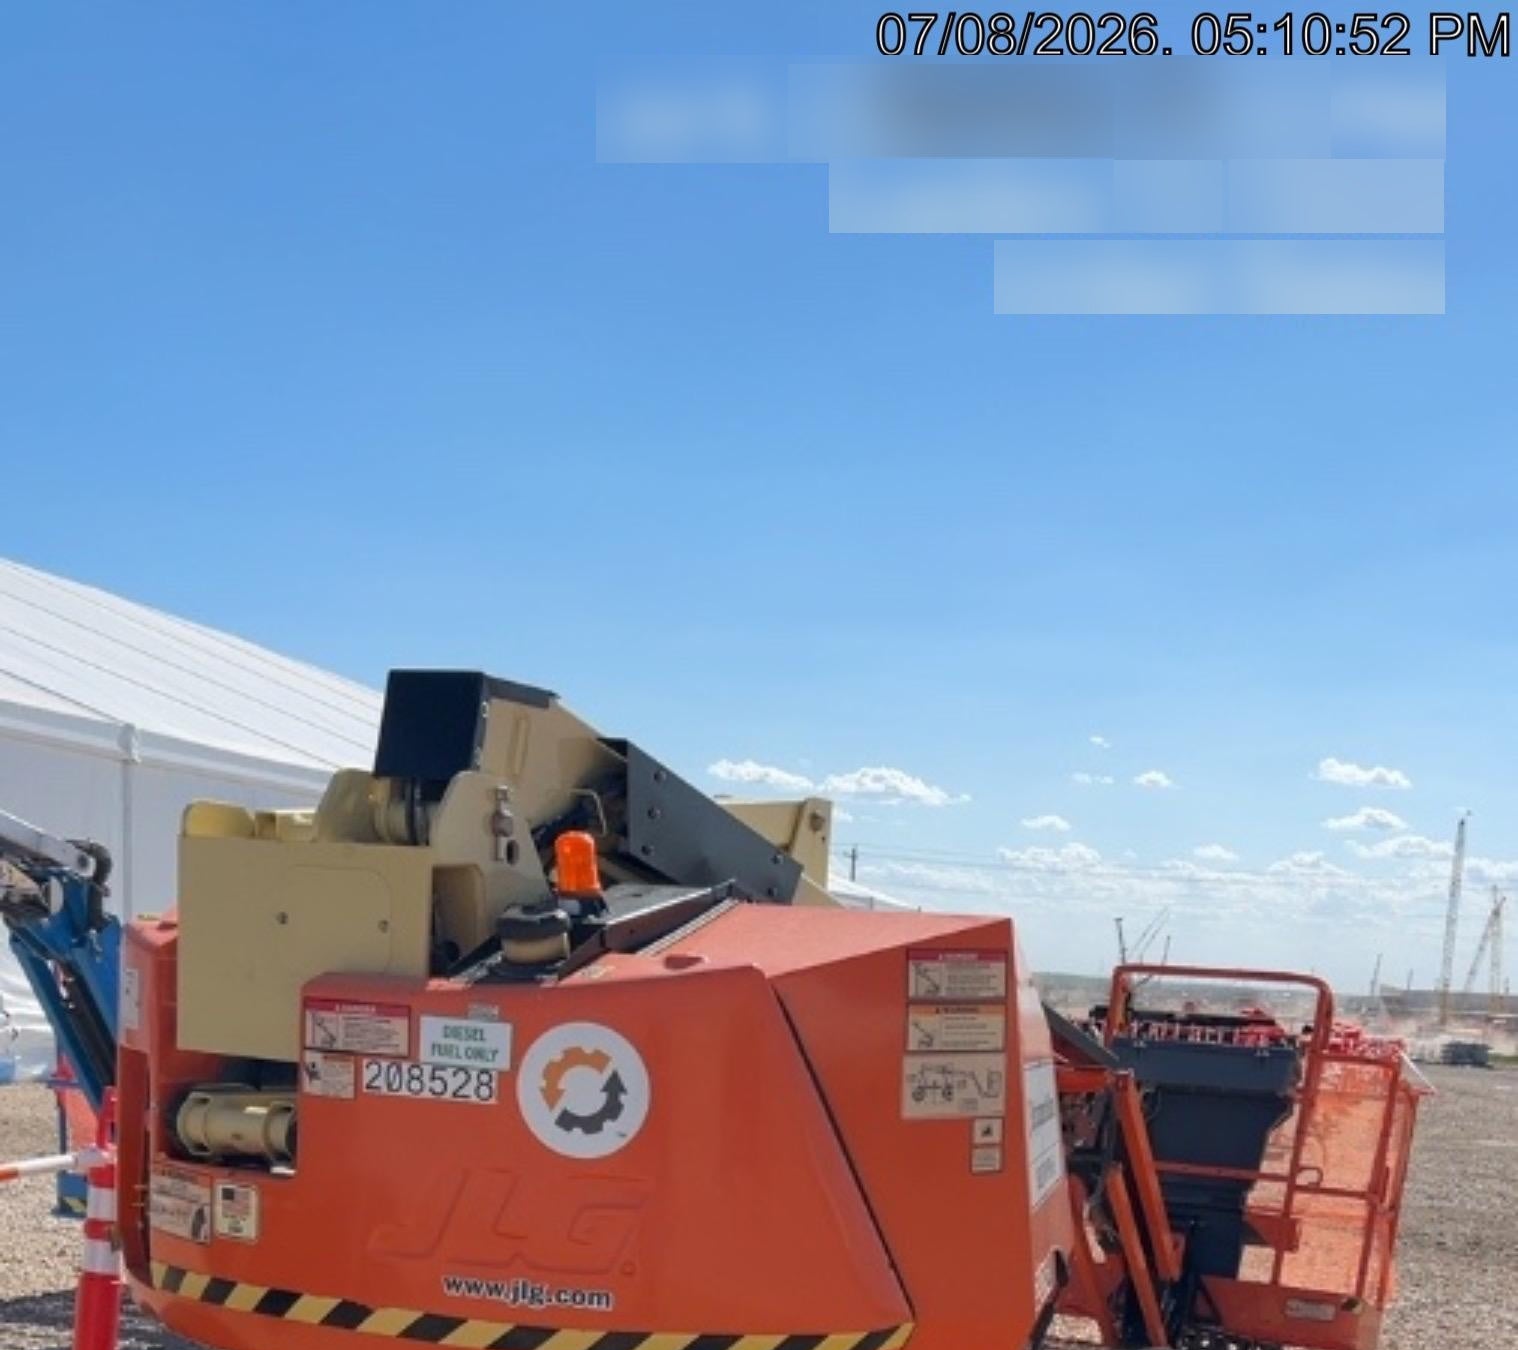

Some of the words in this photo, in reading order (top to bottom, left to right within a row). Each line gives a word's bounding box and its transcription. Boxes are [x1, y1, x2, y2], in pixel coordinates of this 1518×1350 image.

[443, 1024, 487, 1041] DIESEL
[431, 1042, 462, 1059] FUEL
[464, 1046, 498, 1062] ONLY
[364, 1061, 495, 1102] 208528
[443, 1276, 612, 1309] www.jlg.com
